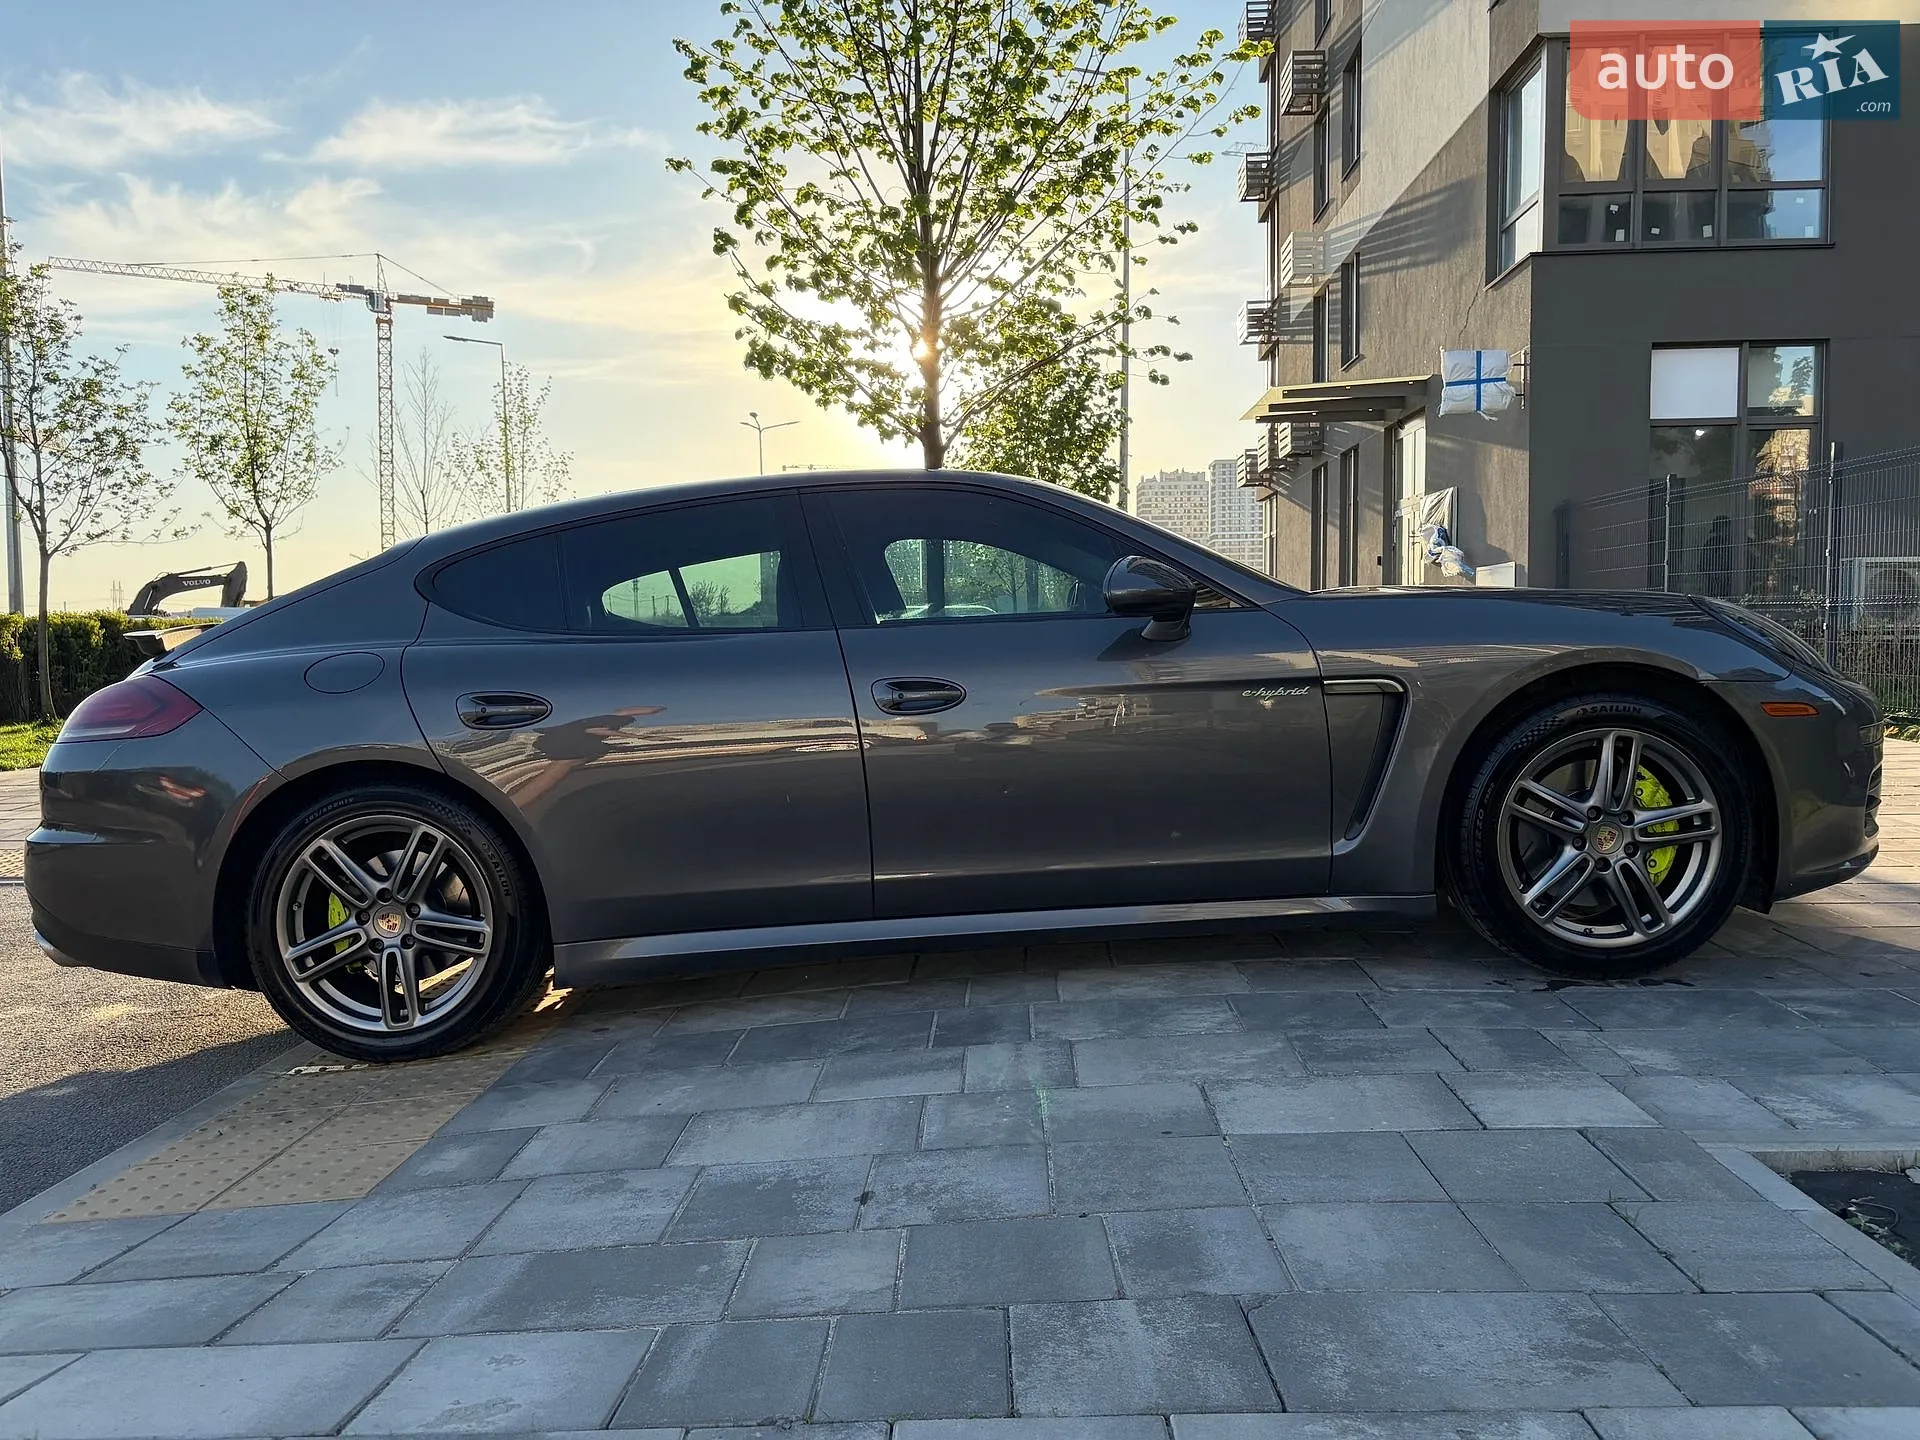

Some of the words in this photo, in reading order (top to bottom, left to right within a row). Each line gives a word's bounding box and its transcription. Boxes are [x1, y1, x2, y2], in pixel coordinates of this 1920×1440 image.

[1242, 686, 1311, 700] e-hybrid
[1590, 704, 1642, 714] SAILUN
[487, 852, 512, 897] SAILUN
